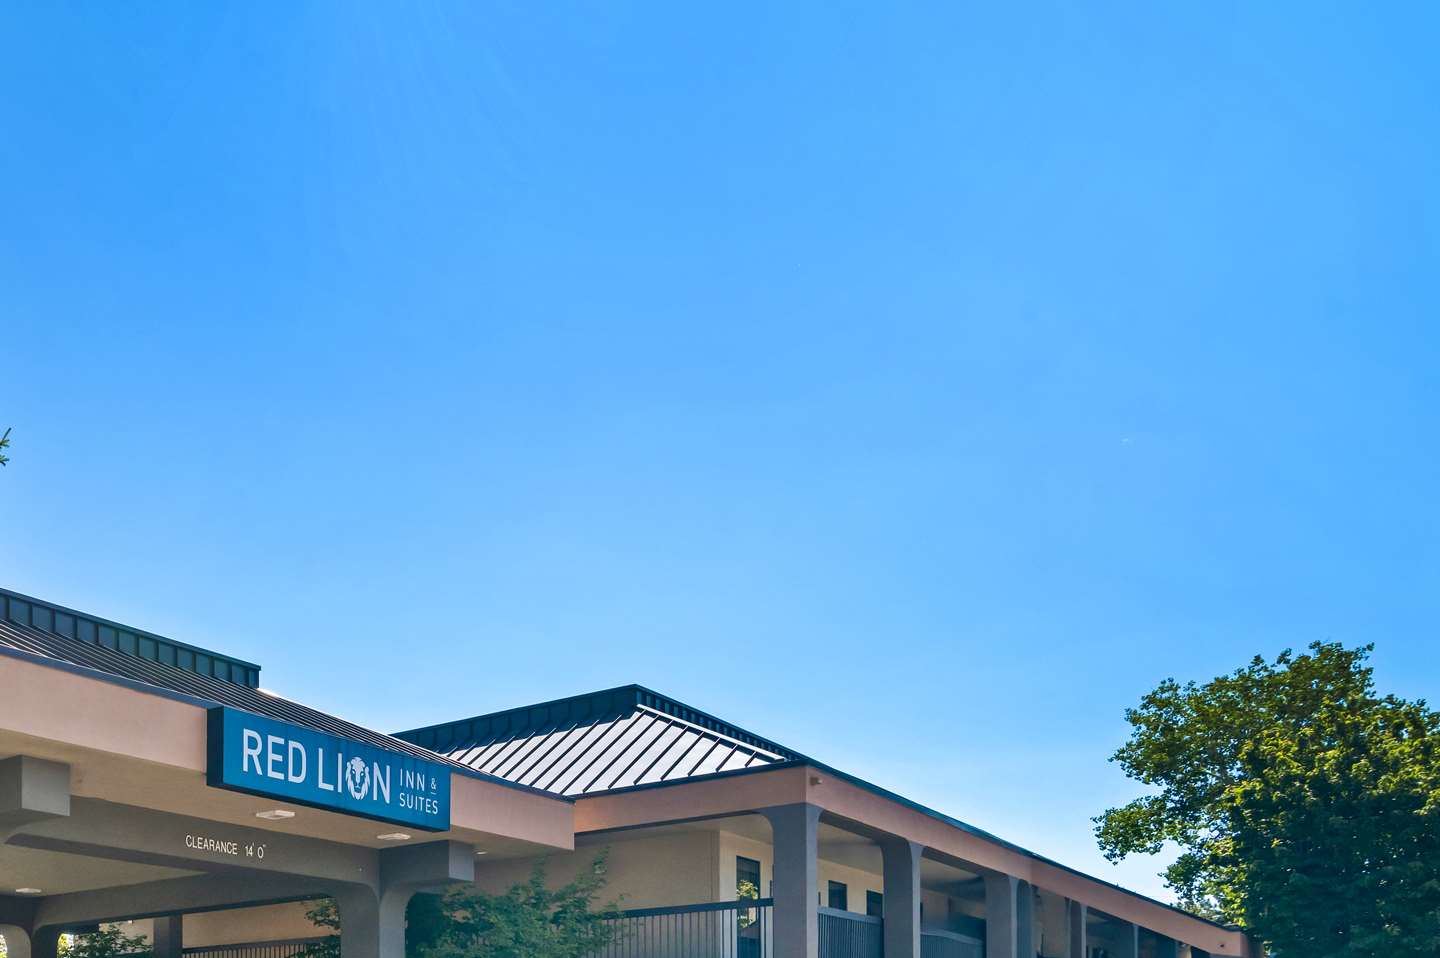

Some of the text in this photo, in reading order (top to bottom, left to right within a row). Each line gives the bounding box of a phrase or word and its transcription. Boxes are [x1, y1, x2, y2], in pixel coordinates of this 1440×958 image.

[242, 728, 391, 804] RED LION
[399, 769, 437, 795] INN &
[399, 792, 439, 815] SUITES
[185, 834, 238, 855] CLEARANCE
